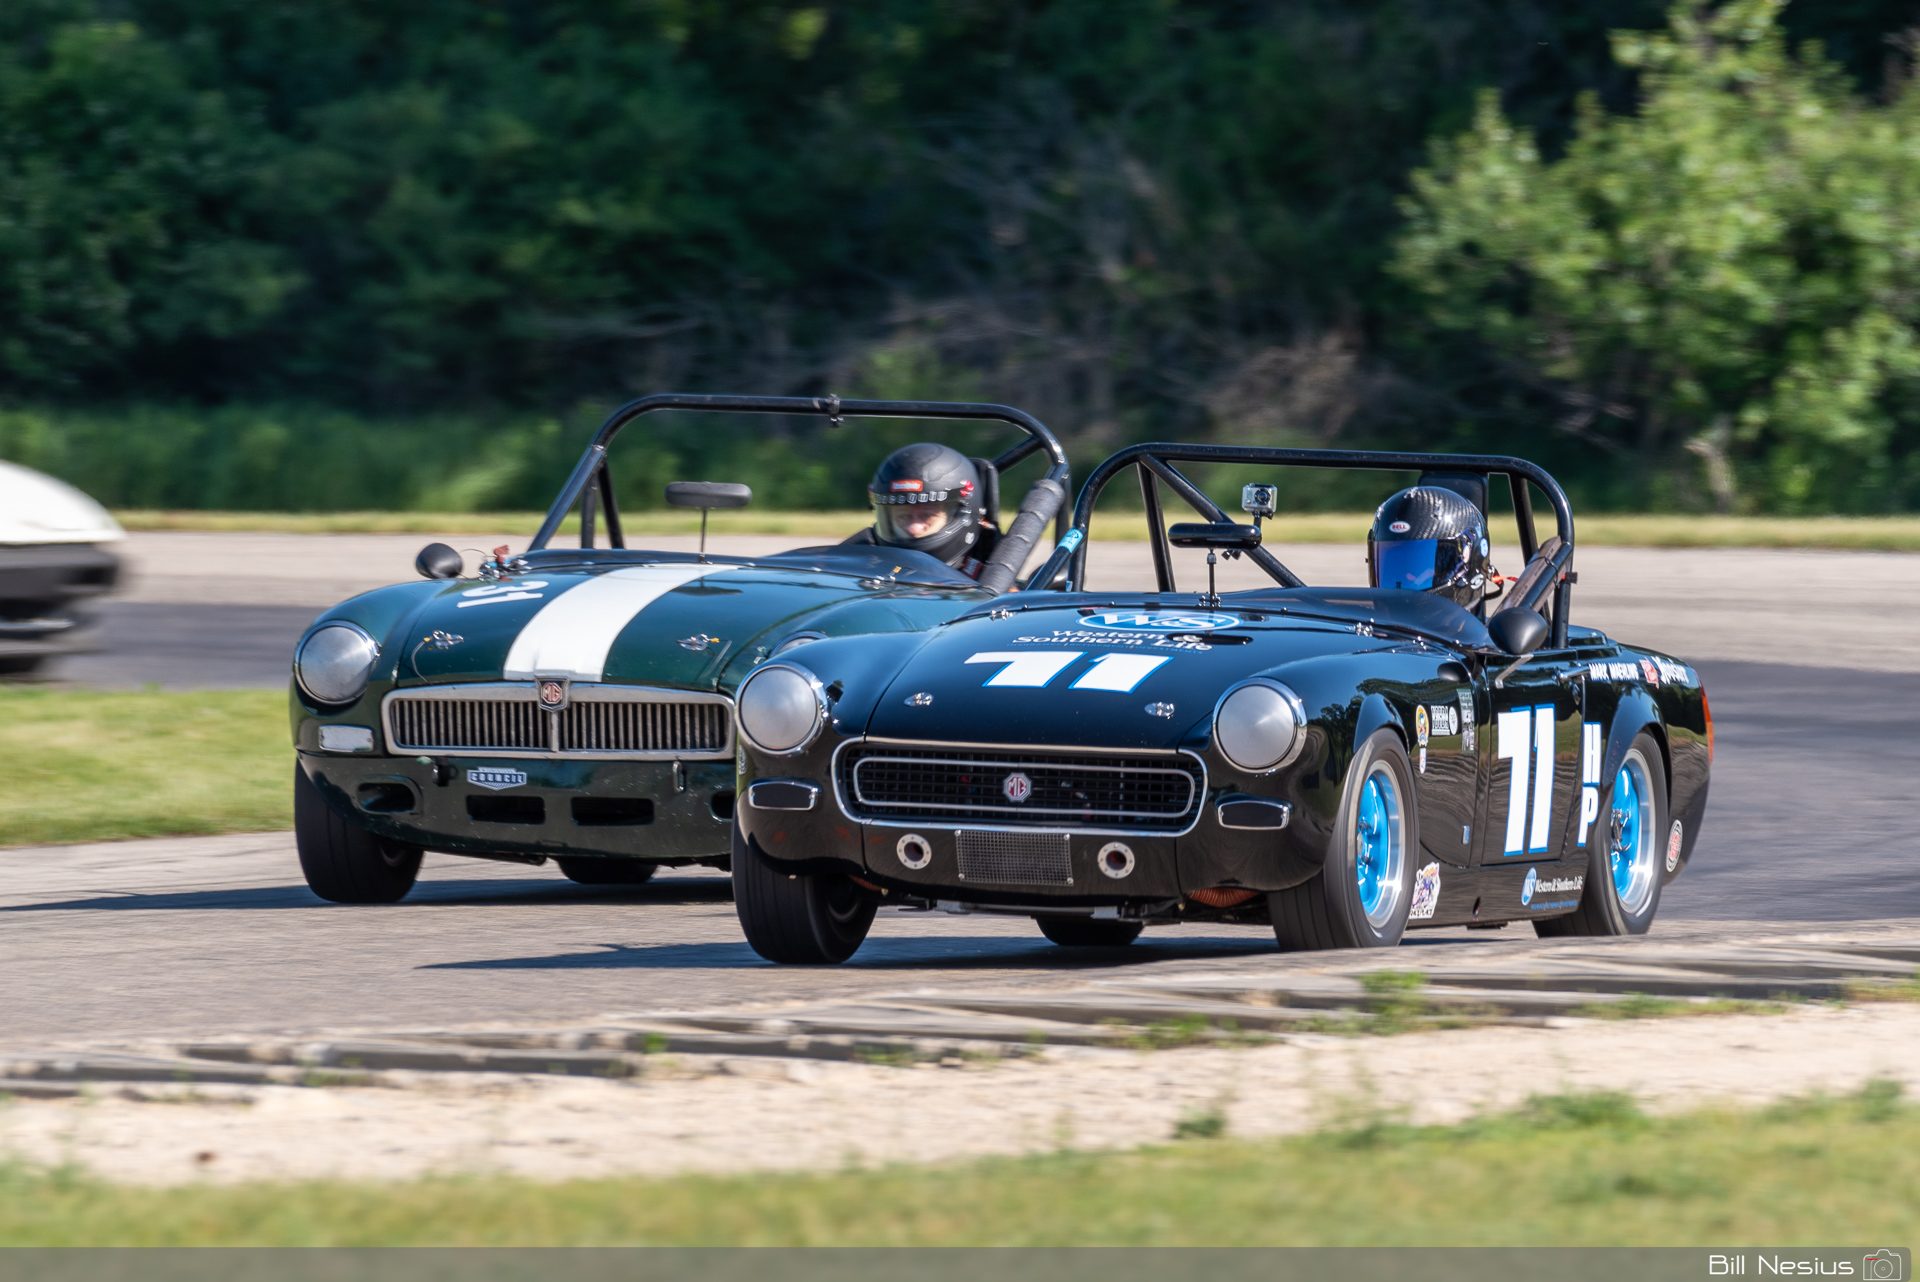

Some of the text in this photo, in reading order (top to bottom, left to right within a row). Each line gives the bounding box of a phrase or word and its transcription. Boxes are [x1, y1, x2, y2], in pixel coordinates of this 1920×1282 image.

[1012, 636, 1213, 651] Southern Life
[1052, 630, 1165, 640] Western
[964, 651, 1174, 694] 71
[542, 683, 562, 703] MG
[1497, 703, 1555, 856] 71
